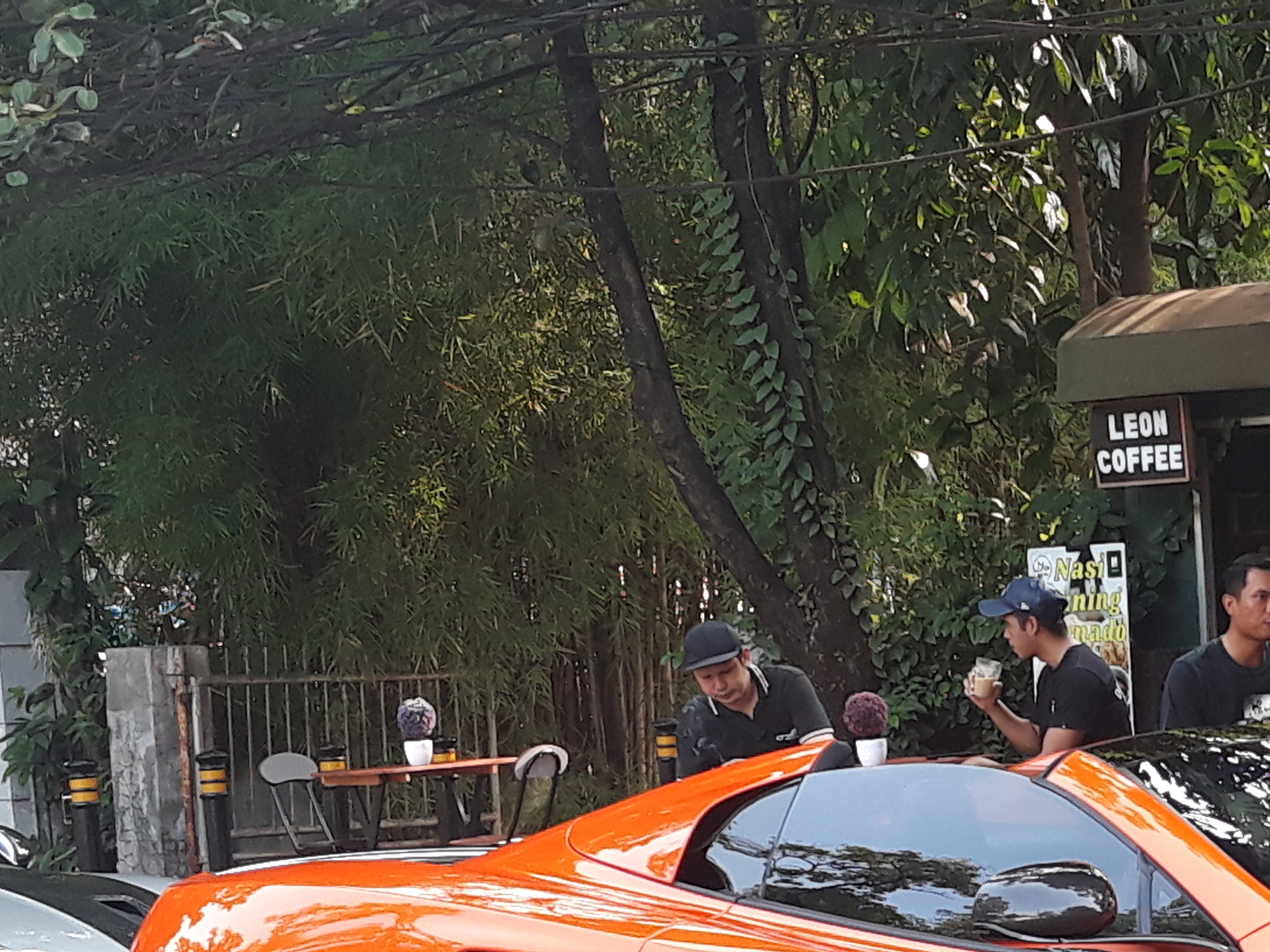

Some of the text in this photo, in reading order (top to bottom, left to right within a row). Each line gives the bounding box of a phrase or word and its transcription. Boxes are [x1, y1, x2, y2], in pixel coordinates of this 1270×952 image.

[1108, 409, 1169, 441] LEON
[1096, 444, 1183, 474] COFFEE
[1053, 552, 1105, 582] Nasi
